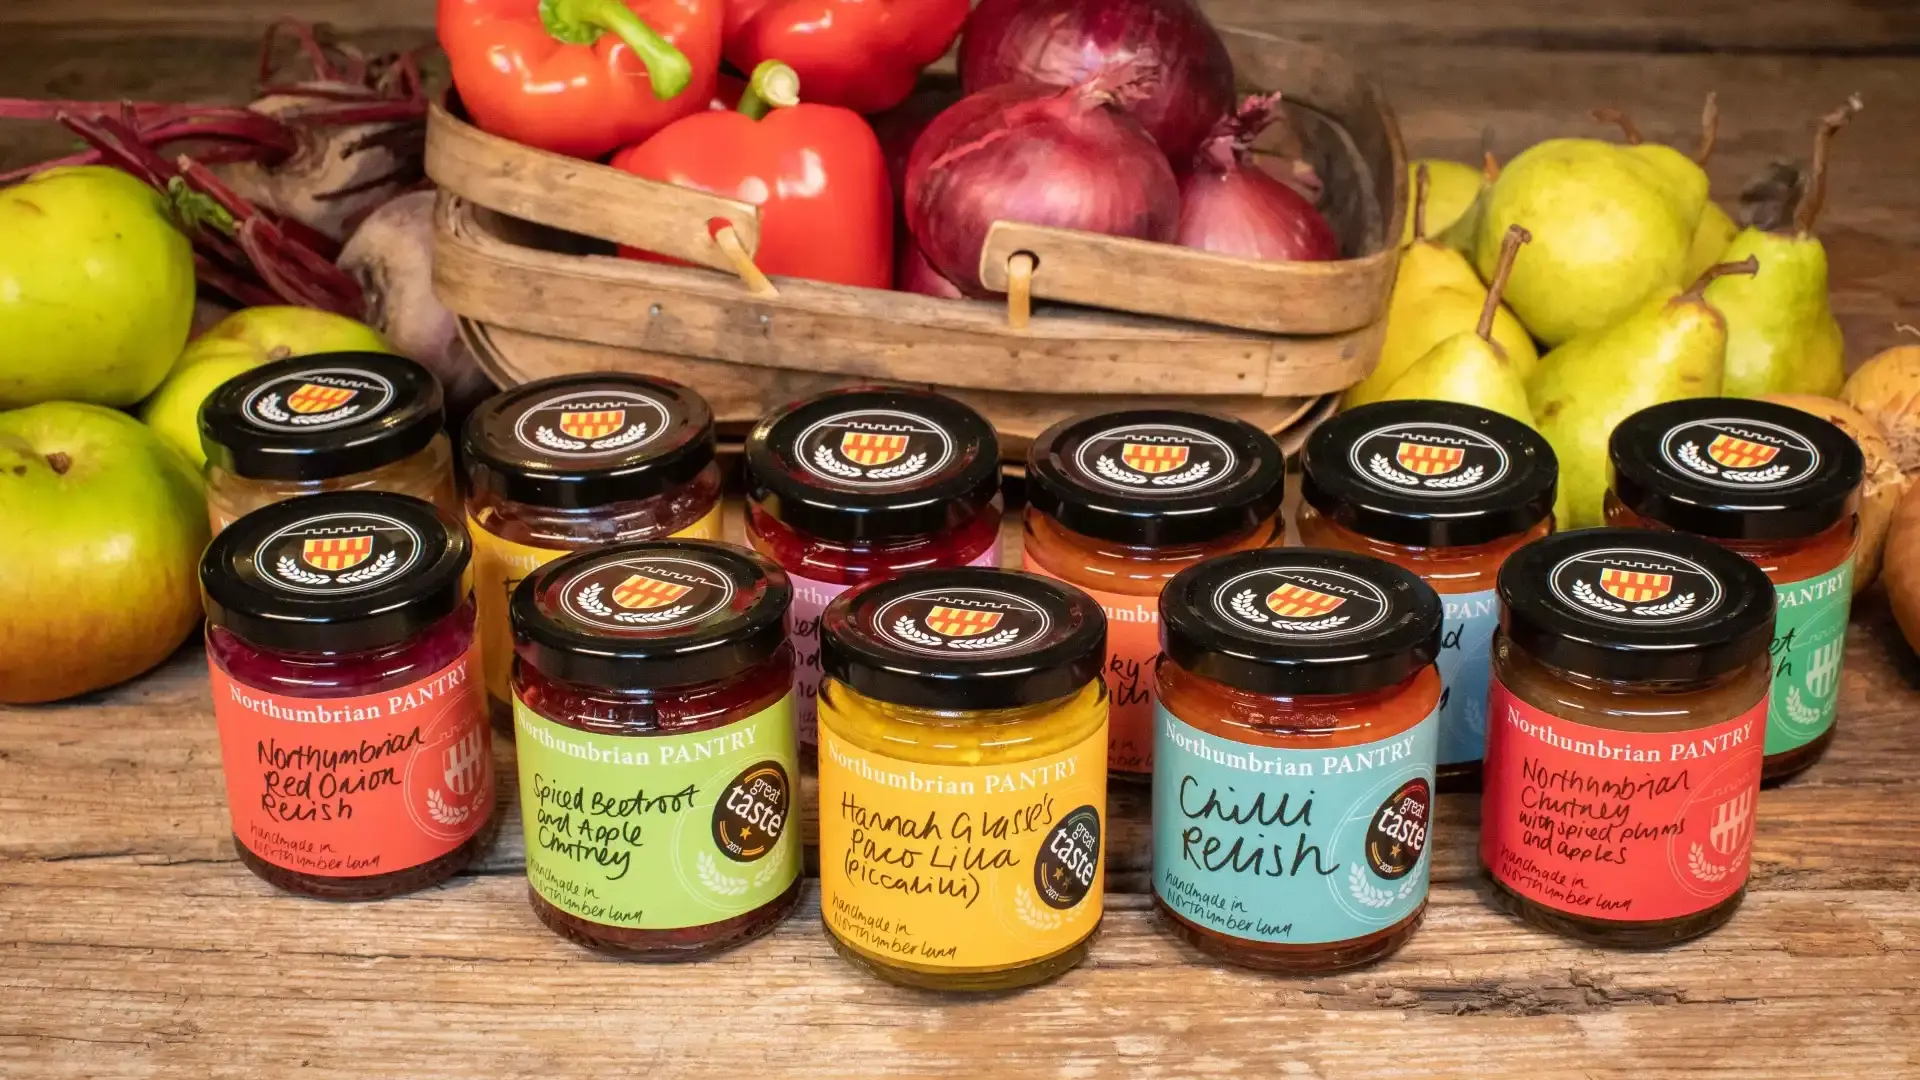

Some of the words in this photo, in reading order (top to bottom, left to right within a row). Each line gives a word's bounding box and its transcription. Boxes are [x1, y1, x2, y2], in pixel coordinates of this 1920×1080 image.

[1443, 598, 1494, 620] PAN
[229, 683, 380, 724] Northumbrian
[387, 660, 467, 715] PANTRY
[258, 726, 425, 772] Northumbrian
[517, 713, 650, 766] Northumbrian
[659, 724, 758, 766] PANTRY
[1165, 718, 1314, 776] Northumbrian
[1322, 734, 1417, 776] PANTRY
[1507, 703, 1662, 763] Northumbrian
[1669, 720, 1754, 762] PANTRY
[264, 770, 312, 800] Red
[319, 767, 402, 799] Onion
[828, 740, 975, 795] Northumbrian
[984, 754, 1080, 795] PANTRY
[1522, 757, 1690, 801] Northumbrian
[261, 793, 353, 823] Relish
[533, 773, 584, 813] Spiced
[591, 784, 700, 817] Beetroot
[726, 785, 782, 837] taste
[750, 778, 781, 805] great
[1179, 775, 1316, 827] Chilli
[1400, 797, 1425, 819] great
[1520, 786, 1631, 829] Chutney
[250, 820, 314, 854] handmade
[319, 843, 333, 854] in
[537, 808, 571, 837] and
[578, 821, 644, 848] Apple
[841, 791, 943, 841] Hannah
[1072, 822, 1096, 852] great
[1377, 806, 1425, 851] taste
[1518, 810, 1554, 834] with
[1557, 817, 1612, 844] spiced
[1619, 818, 1686, 844] plums
[253, 841, 381, 870] Northumberland
[538, 826, 631, 881] Chutney
[726, 841, 743, 855] 2021
[850, 828, 922, 868] Paco
[1050, 827, 1094, 887] taste
[1181, 826, 1341, 877] Relish
[1501, 842, 1566, 886] handmade
[1571, 875, 1589, 890] in
[1522, 830, 1553, 856] and
[1557, 840, 1628, 865] apples
[529, 857, 580, 896] handmade
[584, 885, 600, 900] in
[1045, 885, 1060, 901] 2021
[1165, 867, 1227, 910] handmade
[1231, 899, 1248, 913] in
[1501, 863, 1633, 911] Northumberland
[832, 891, 890, 932] handmade
[896, 923, 914, 936] in
[1167, 888, 1293, 938] Northumberland
[834, 912, 957, 961] Northumberland
